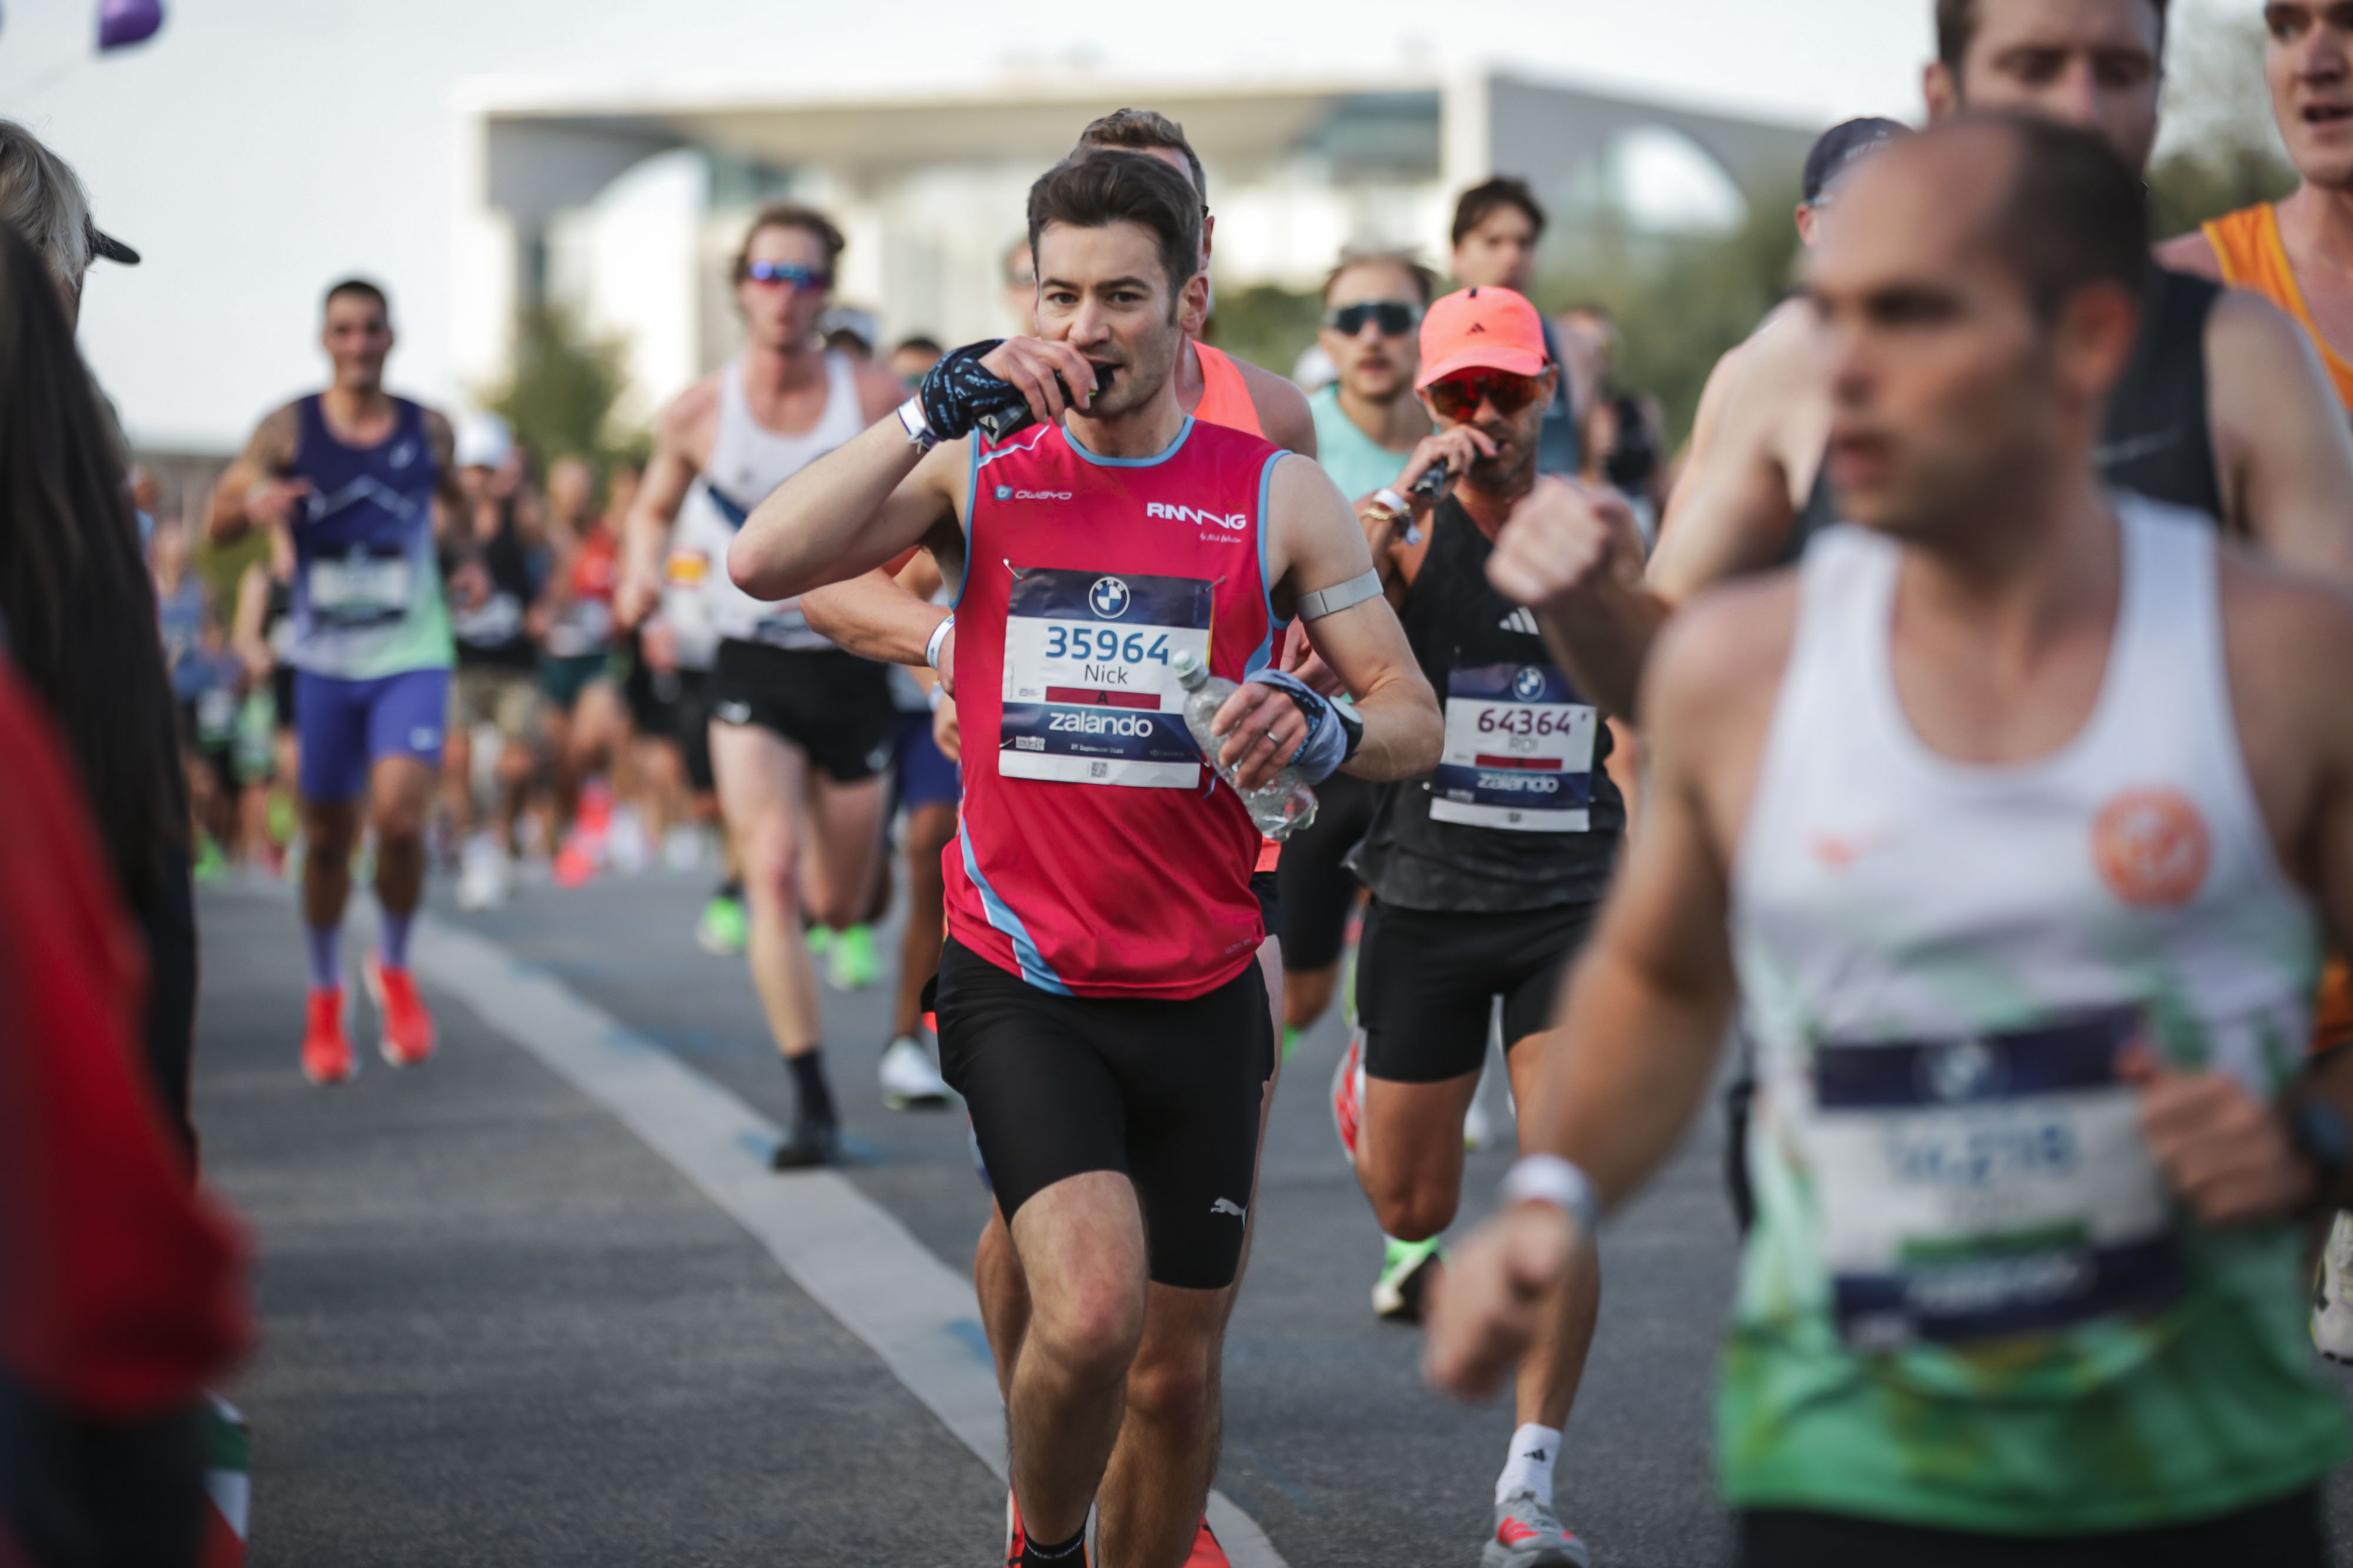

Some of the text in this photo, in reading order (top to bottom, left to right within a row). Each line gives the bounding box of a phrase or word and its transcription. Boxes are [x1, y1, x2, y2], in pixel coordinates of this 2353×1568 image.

[1045, 626, 1169, 665] 35964
[1084, 664, 1128, 685] Nick
[1096, 690, 1109, 705] A
[1049, 710, 1153, 738] zalando
[1478, 708, 1571, 736] 64364
